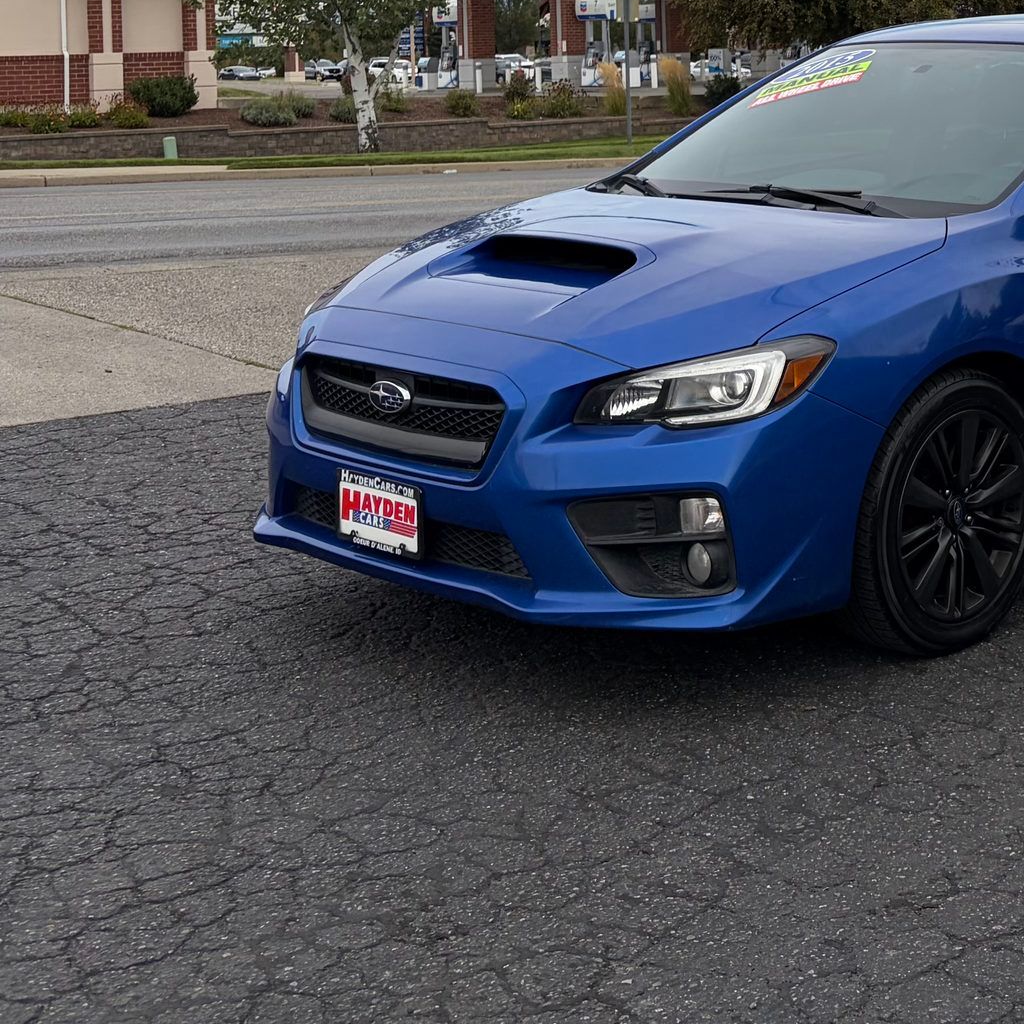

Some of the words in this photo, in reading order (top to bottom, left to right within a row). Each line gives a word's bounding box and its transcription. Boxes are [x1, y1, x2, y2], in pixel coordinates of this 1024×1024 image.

[792, 52, 855, 78] 2015
[753, 94, 776, 107] ALL
[777, 81, 820, 99] WHEEL
[821, 72, 865, 88] DRIVE
[762, 64, 864, 95] MANUAL
[342, 487, 416, 524] HAYDEN
[359, 513, 384, 529] CARS
[353, 536, 370, 546] COEUR
